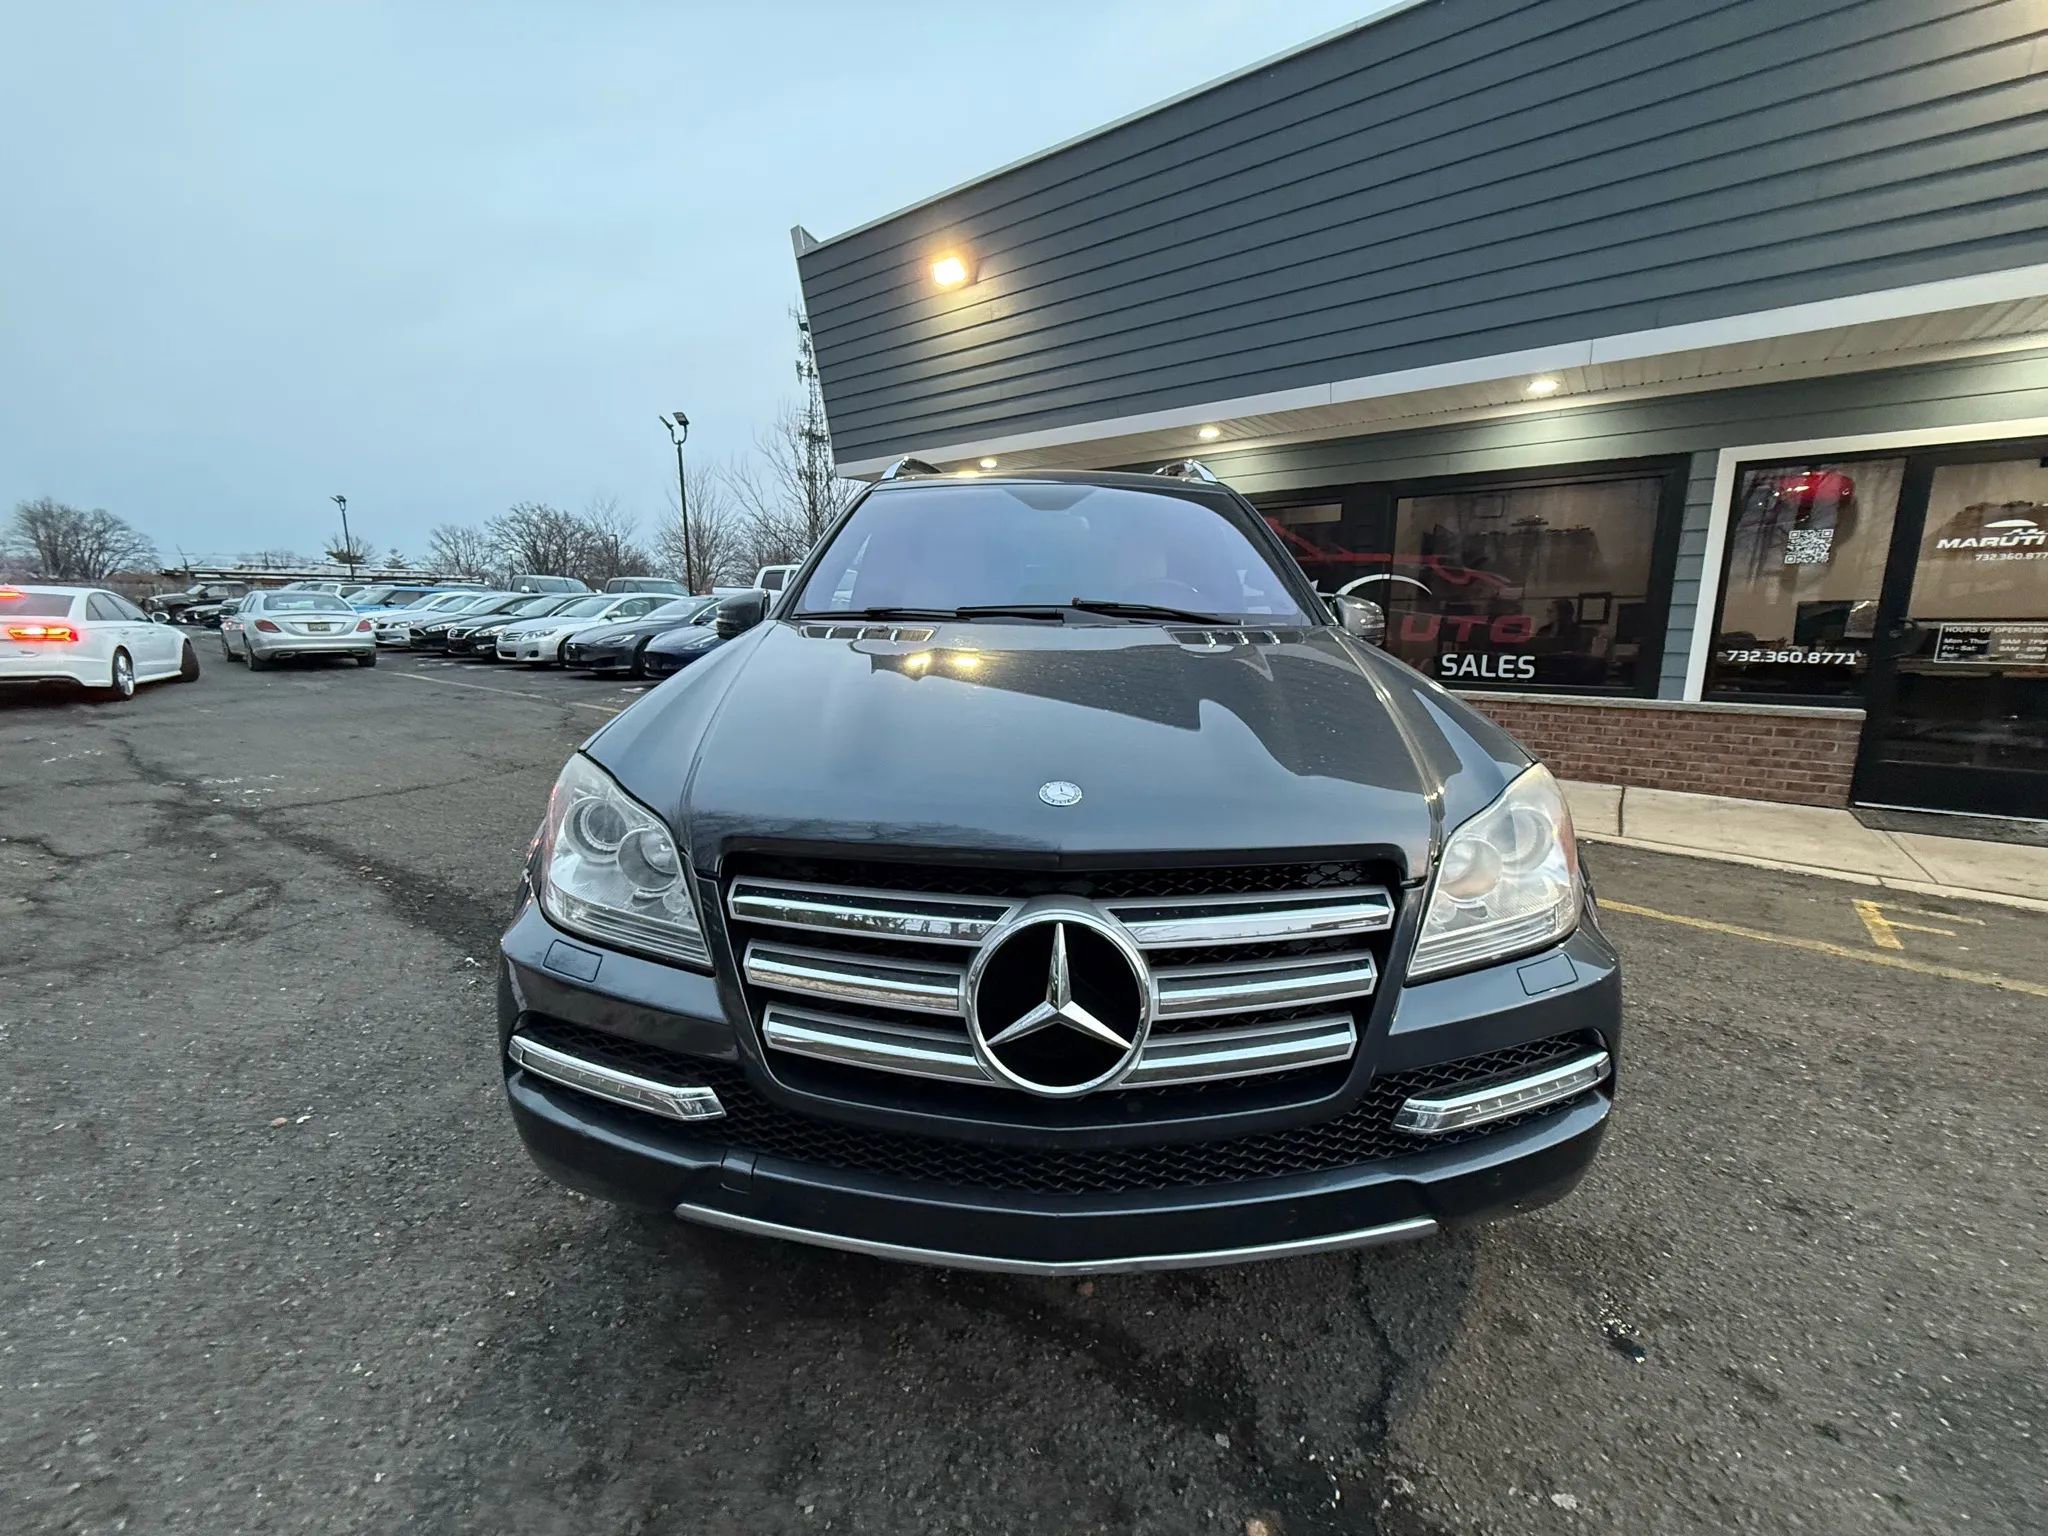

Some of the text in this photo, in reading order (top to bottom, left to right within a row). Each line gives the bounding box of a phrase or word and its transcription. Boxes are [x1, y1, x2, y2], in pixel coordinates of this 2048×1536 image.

[1936, 535, 2046, 549] MARUTI
[1975, 552, 2048, 561] 732.360.877
[1399, 614, 1534, 643] UTO
[1994, 626, 2048, 634] OPERATIO
[1727, 650, 1857, 665] 732.360.8771
[1441, 654, 1536, 679] SALES
